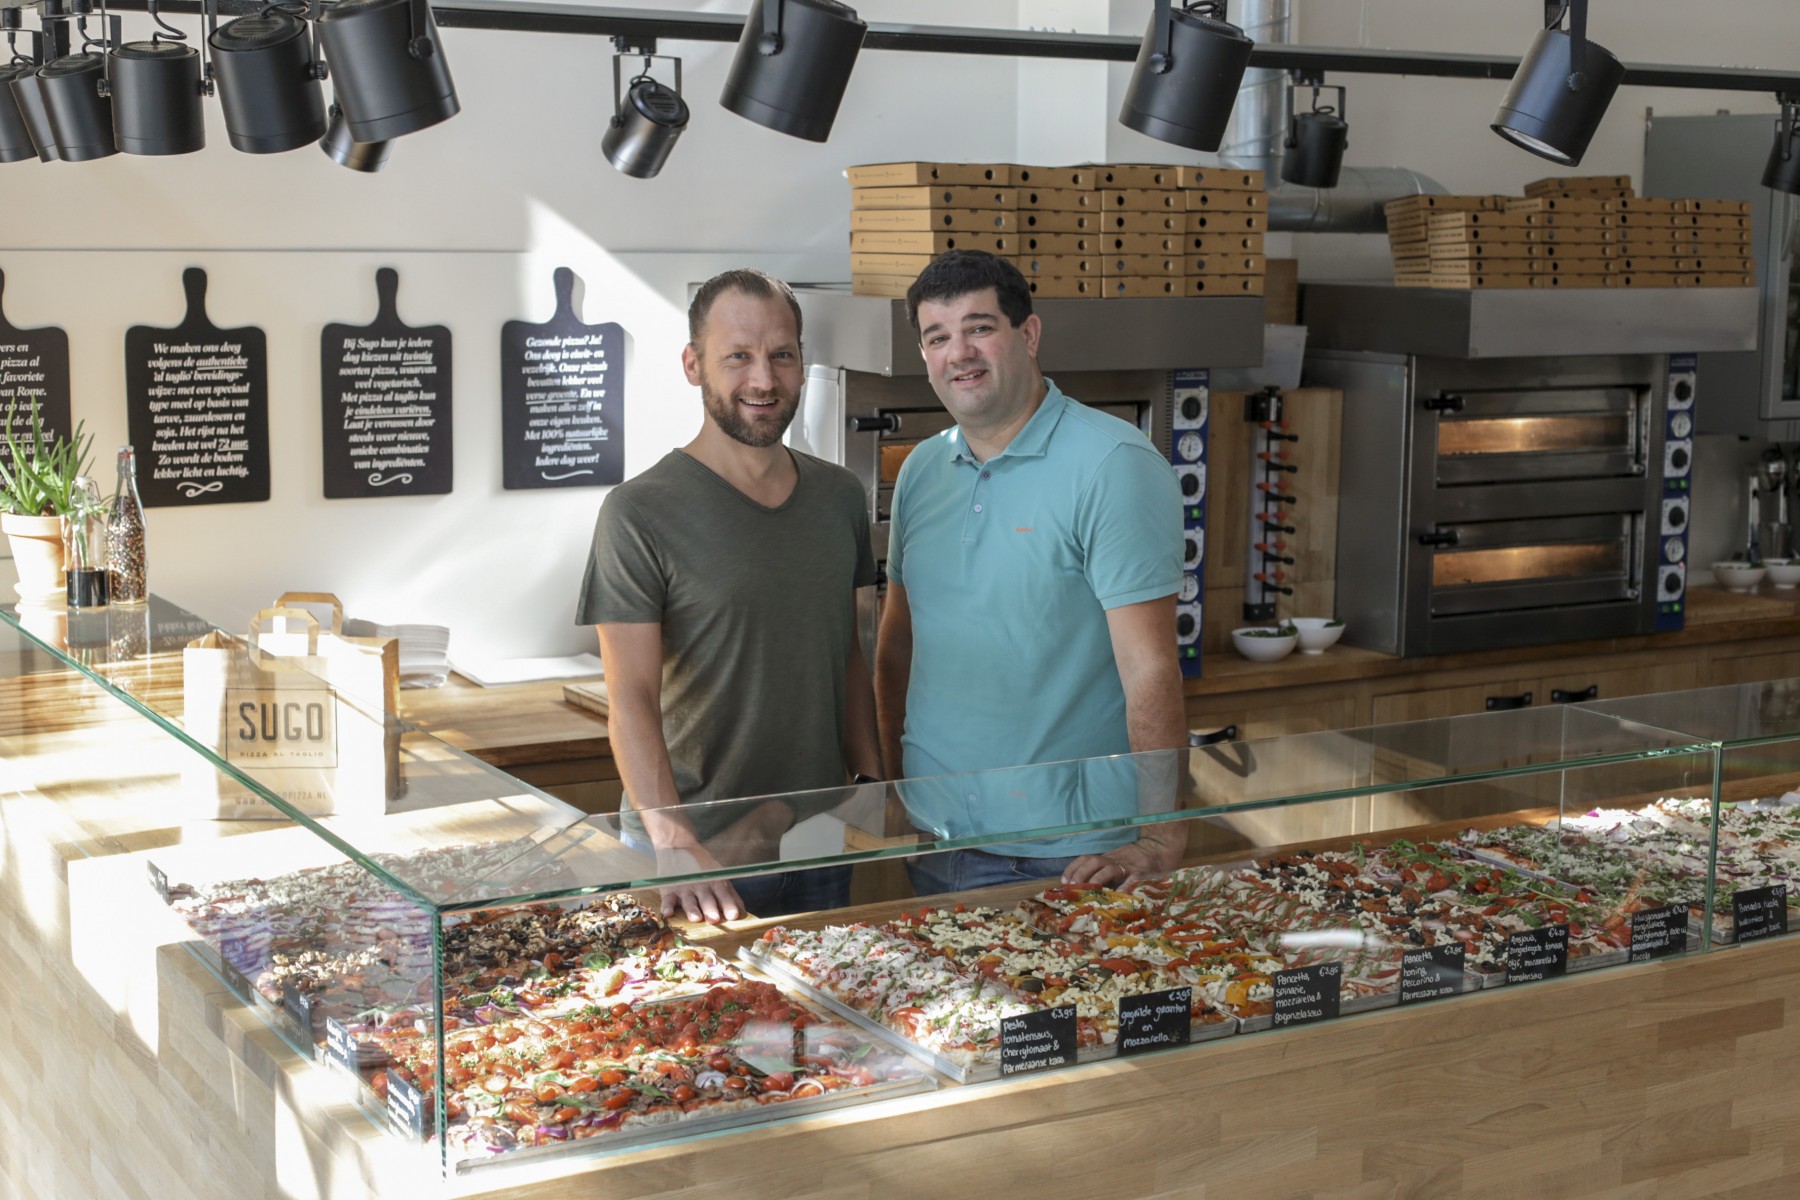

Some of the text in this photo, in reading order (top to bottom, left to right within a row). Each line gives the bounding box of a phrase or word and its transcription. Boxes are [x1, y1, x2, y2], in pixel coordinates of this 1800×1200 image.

[154, 341, 241, 354] We maken ons deeg
[343, 337, 433, 350] Bij Sugo kun je iedere
[526, 334, 603, 348] Gezonde pizza? Ja!
[343, 351, 433, 364] dag kiezen uit twintig
[525, 348, 604, 362] Ons deeg is eiwit- en
[148, 355, 248, 370] volgens de authentieke
[522, 362, 558, 375] vezelrijk.
[559, 363, 580, 373] Onze
[194, 370, 243, 382] bereidings-
[339, 365, 437, 377] soorten pizza, waarvan
[355, 377, 422, 390] veel vegetarisch.
[527, 374, 604, 387] bevatten lekker veel
[148, 382, 250, 398] wijze: met een speciaal
[525, 388, 605, 401] verse groente. En we
[341, 390, 436, 405] Met pizza al taglio kun
[149, 397, 249, 412] type meel op basis van
[344, 404, 431, 418] je eindeloos variëren.
[530, 401, 602, 413] maken alles zelf in
[154, 411, 245, 424] tarwe, zuurdesem en
[344, 417, 435, 431] Laat je verrassen door
[529, 415, 602, 428] onze eigen keuken.
[156, 424, 244, 439] soja. Het rijst na het
[348, 430, 430, 442] steeds weer nieuwe,
[524, 427, 608, 440] Met 100% natuurlijke
[152, 440, 185, 451] kneden
[187, 441, 199, 450] tot
[201, 439, 217, 449] wel
[218, 438, 230, 449] 72
[350, 443, 429, 456] unieke combinaties
[541, 442, 592, 455] ingrediënten.
[158, 452, 243, 465] Zo wordt de bodem
[354, 457, 425, 470] van ingrediënten.
[535, 453, 600, 466] Iedere dag weer!
[154, 468, 182, 479] lekker
[183, 467, 202, 477] licht
[216, 465, 249, 478] luchtig.
[239, 702, 323, 741] SUGO
[1435, 973, 1440, 982] &
[1316, 992, 1321, 1000] &
[1003, 1030, 1053, 1044] tomatensaus,
[1053, 1040, 1059, 1051] &
